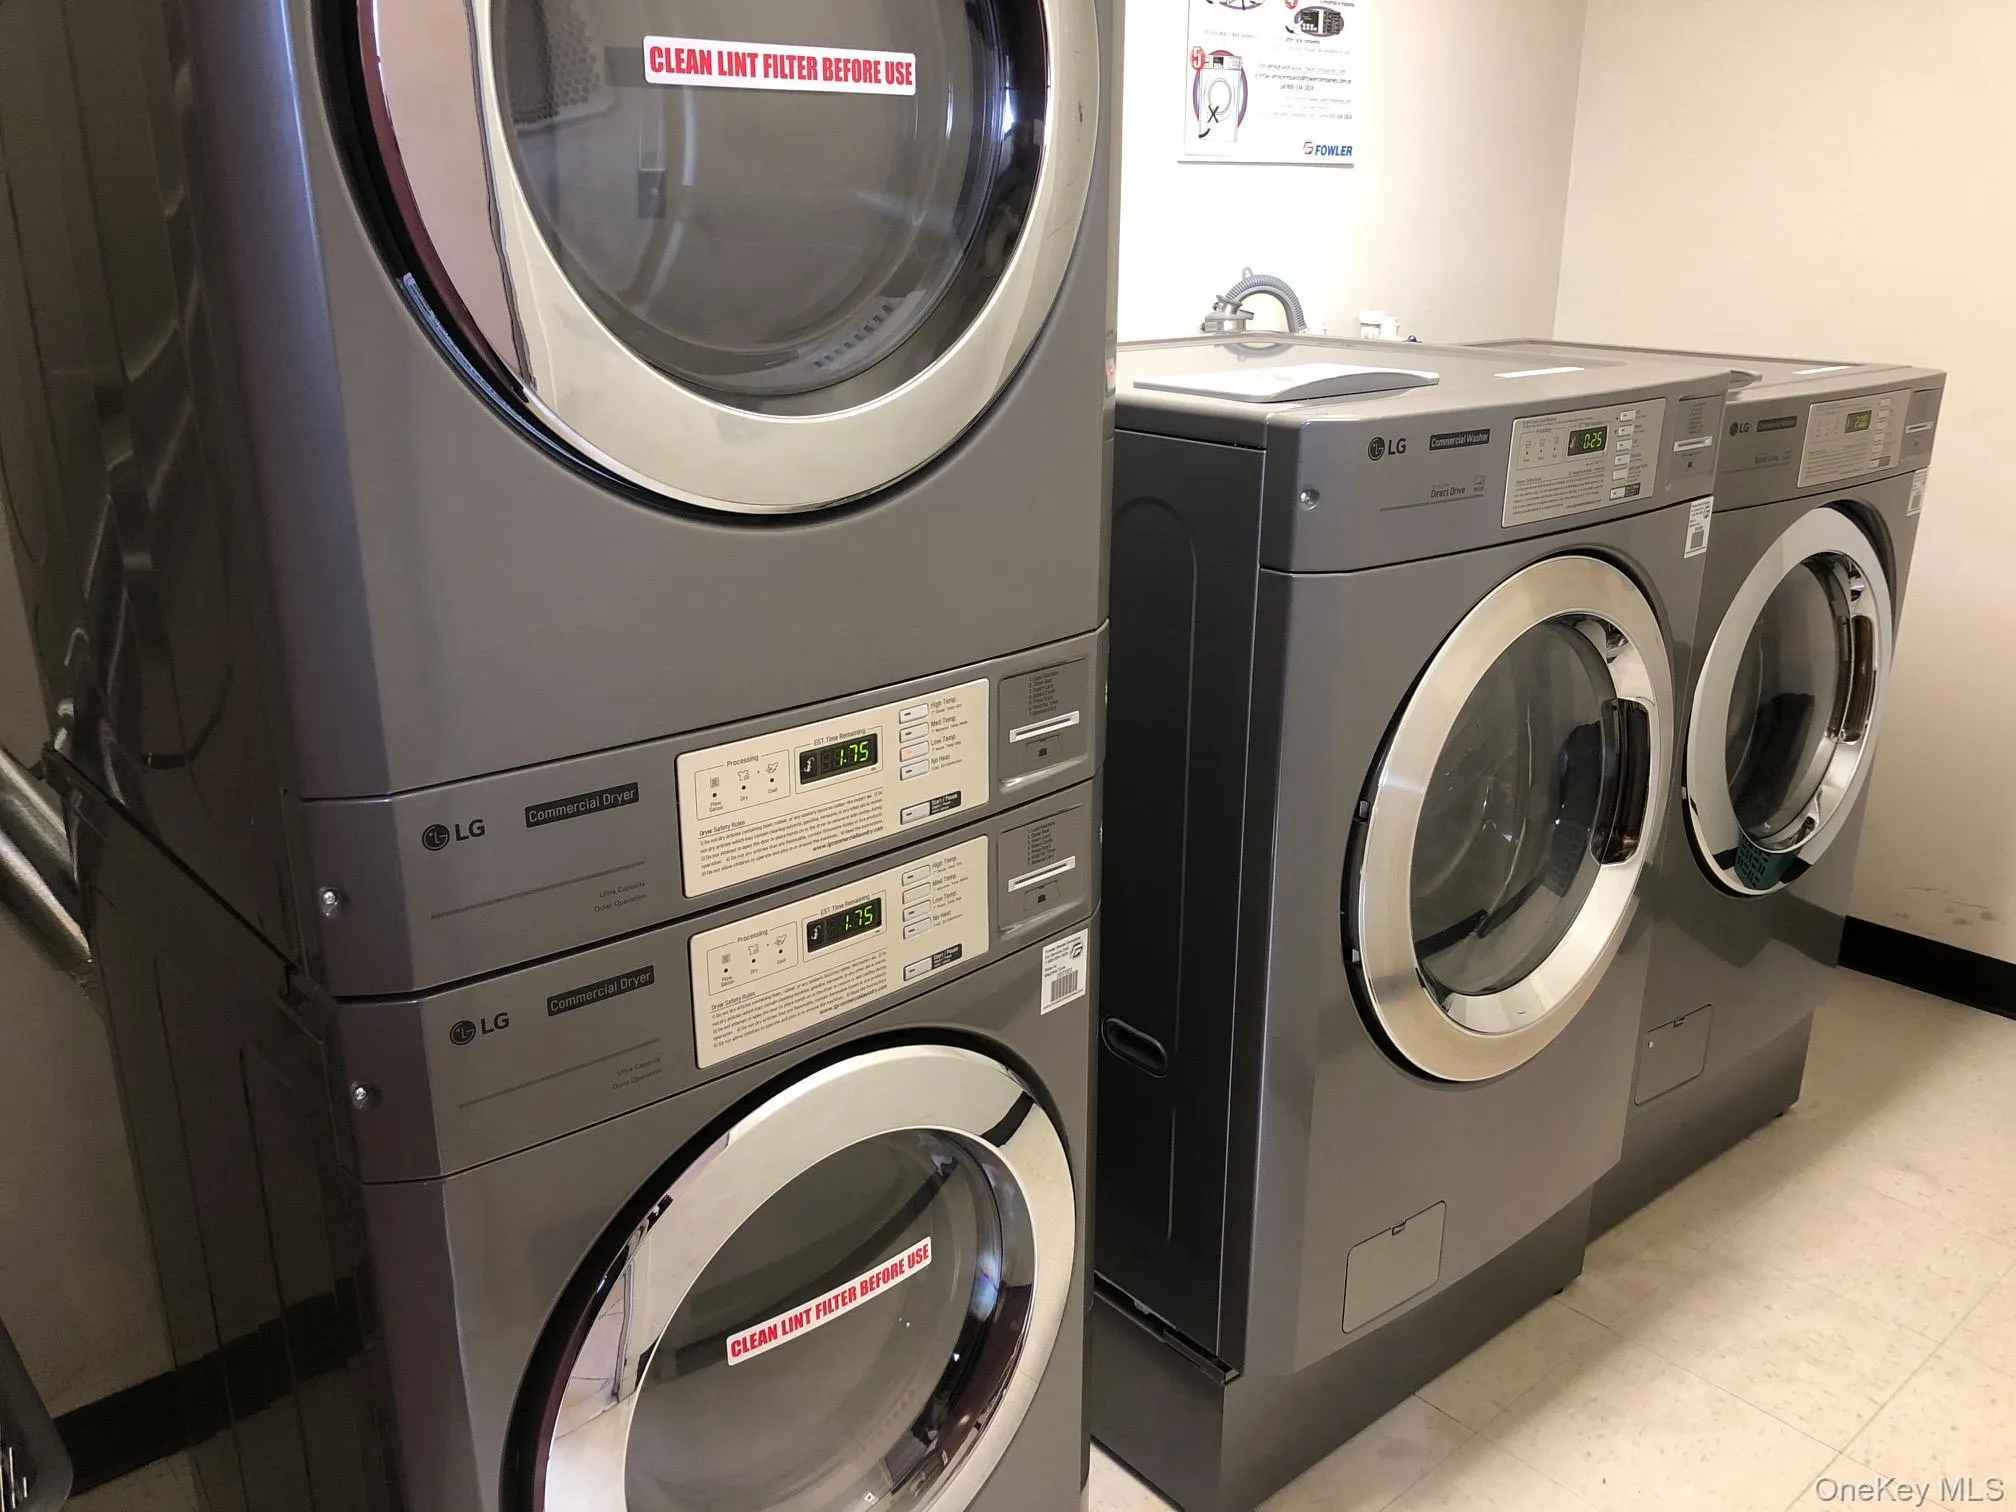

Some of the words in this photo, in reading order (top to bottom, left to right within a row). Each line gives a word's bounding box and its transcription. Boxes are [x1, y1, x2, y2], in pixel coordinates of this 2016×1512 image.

[650, 46, 712, 76] CLEAN
[717, 51, 758, 78] LINT
[763, 54, 818, 81] FILTER
[822, 57, 881, 84] BEFORE
[885, 61, 912, 86] USE
[1314, 144, 1352, 157] FOWLER
[1739, 422, 1749, 433] LG
[1388, 438, 1407, 455] LG
[1431, 435, 1465, 447] Commercial
[1467, 433, 1489, 443] Washer
[930, 700, 942, 709] High
[931, 719, 941, 727] Med
[813, 737, 824, 746] EST
[825, 735, 838, 743] Time
[839, 728, 865, 740] Remaining
[931, 738, 941, 746] Low
[726, 755, 758, 768] Processing
[839, 740, 868, 767] 1.75
[945, 793, 957, 801] Pause
[529, 797, 600, 823] Commercial
[602, 788, 636, 807] Dryer
[455, 819, 486, 841] LG
[699, 828, 712, 837] Dryer
[713, 824, 730, 833] Safety
[731, 820, 745, 828] Rules
[932, 860, 942, 869] High
[932, 877, 942, 886] Med
[820, 906, 830, 915] EST
[831, 903, 844, 911] Time
[844, 894, 870, 907] Remaining
[932, 896, 942, 904] Low
[845, 904, 872, 931] 1.75
[737, 929, 767, 944] Processing
[934, 952, 943, 960] Start
[946, 946, 958, 955] Pause
[551, 982, 618, 1011] Commercial
[620, 971, 651, 991] Dryer
[711, 1002, 723, 1010] Dryer
[724, 996, 741, 1007] Safety
[741, 991, 755, 999] Rules
[481, 1012, 510, 1034] LG
[729, 1324, 779, 1358] CLEAN
[781, 1307, 812, 1338] LINT
[815, 1285, 857, 1320] FILTER
[860, 1260, 905, 1297] BEFORE
[907, 1245, 929, 1270] USE
